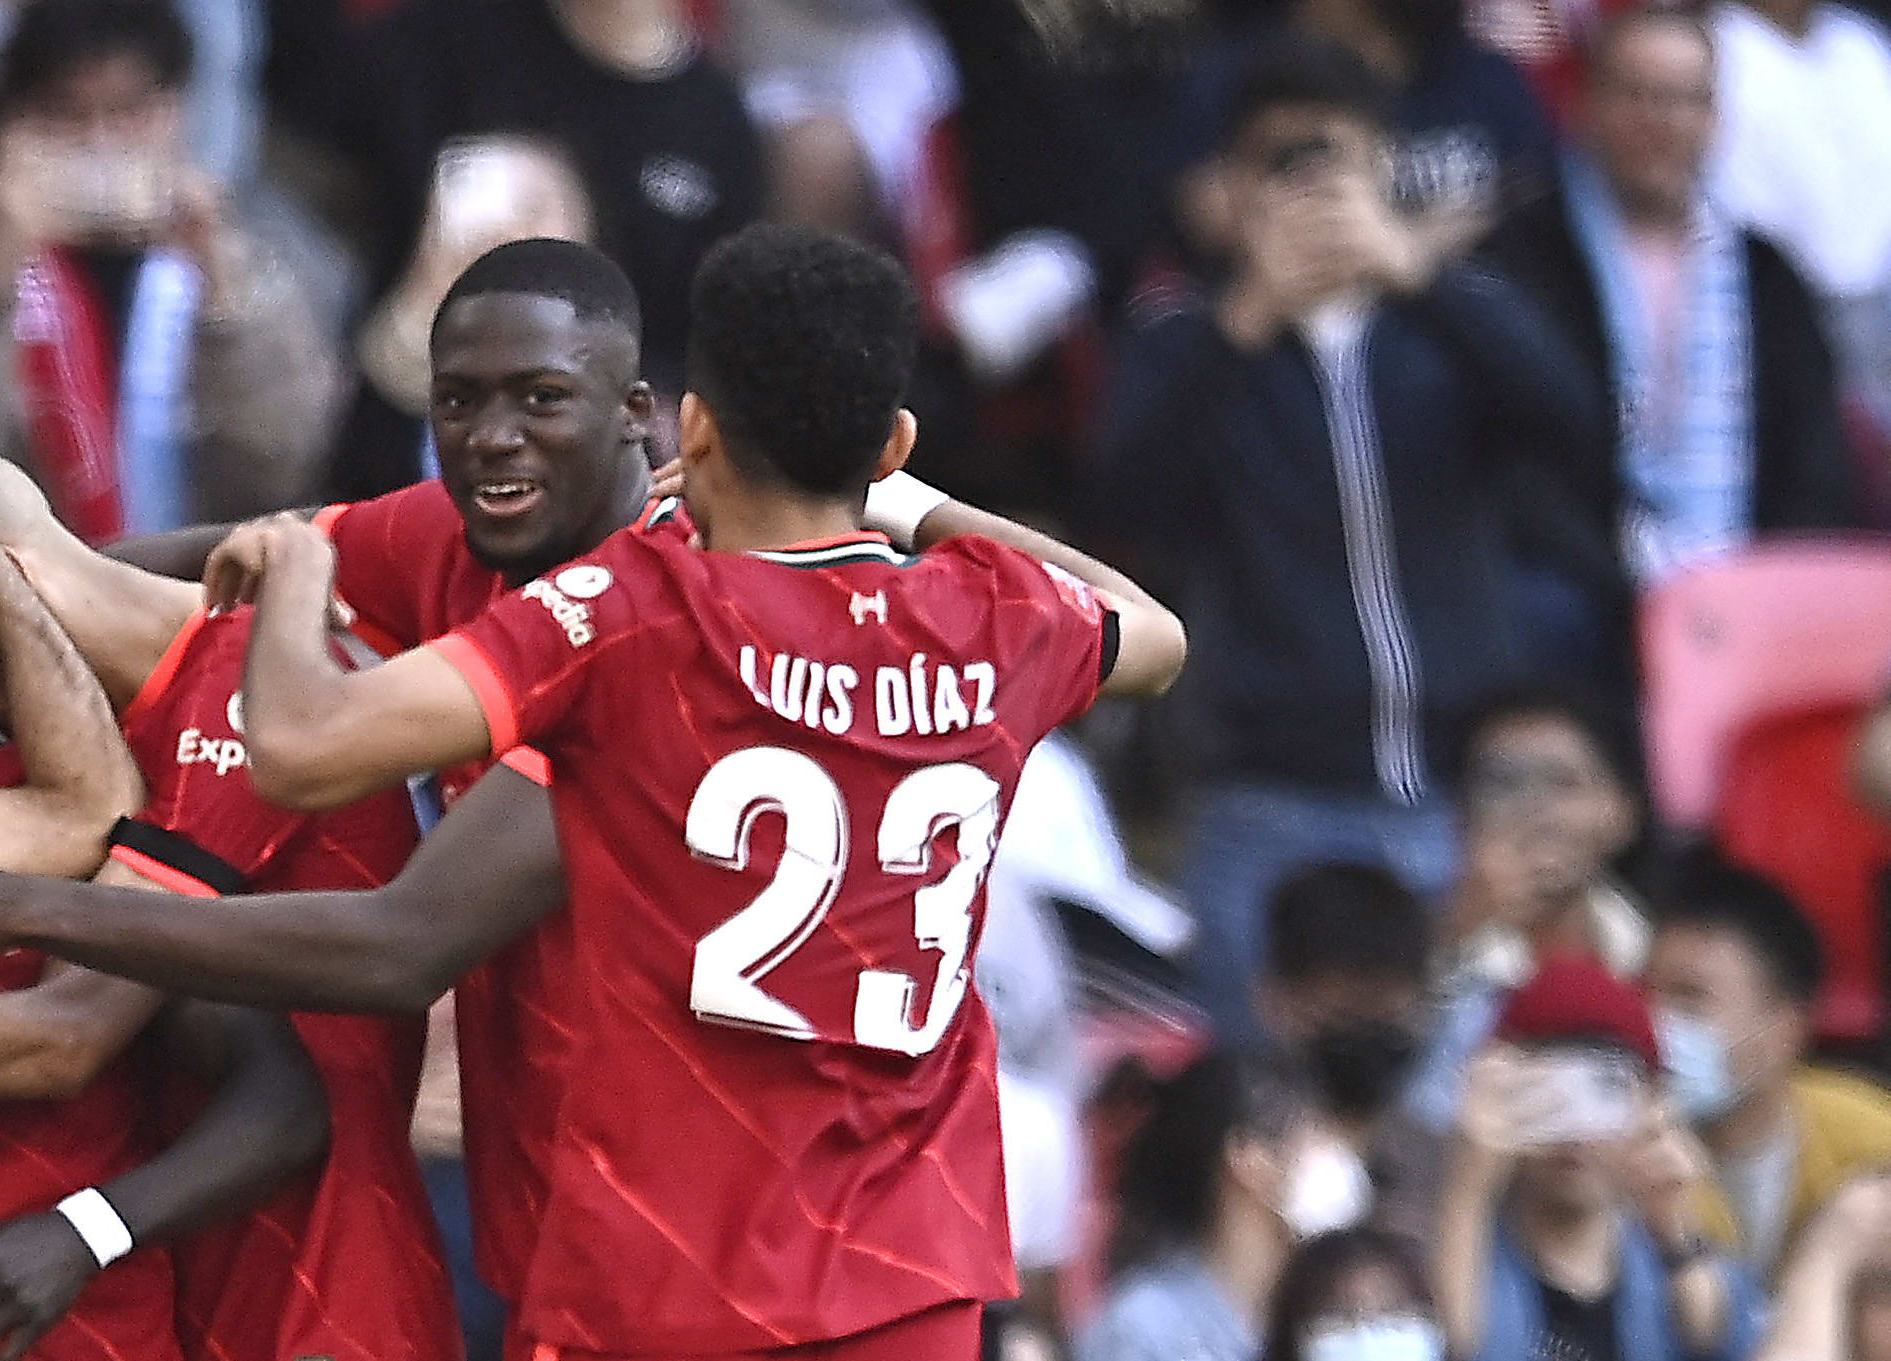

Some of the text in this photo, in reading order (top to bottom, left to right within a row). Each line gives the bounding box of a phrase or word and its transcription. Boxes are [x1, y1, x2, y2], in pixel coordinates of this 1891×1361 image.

[740, 645, 996, 736] LUIS DÍAZ
[685, 746, 1000, 1057] 23
